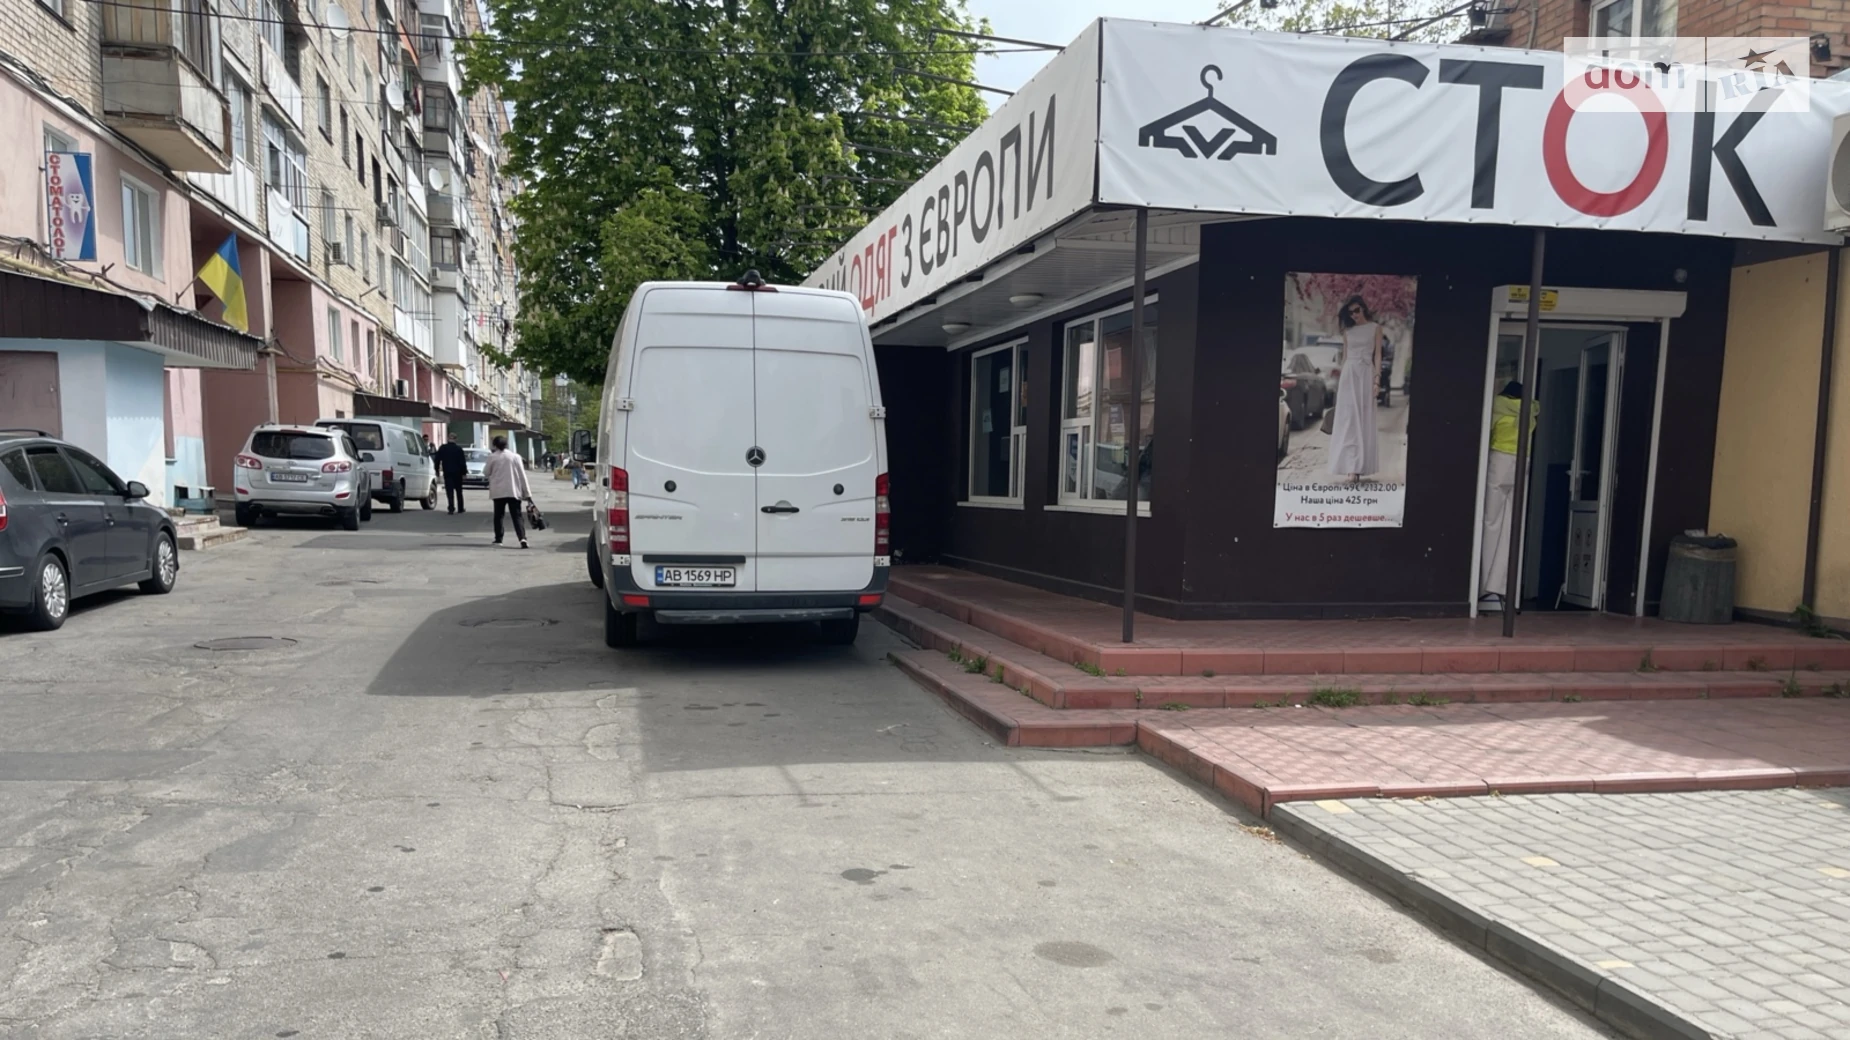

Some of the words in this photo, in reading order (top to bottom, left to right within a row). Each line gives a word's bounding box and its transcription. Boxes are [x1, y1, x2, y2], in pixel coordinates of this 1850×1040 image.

[1320, 53, 1785, 227] СТОК
[49, 154, 65, 258] СТОМАТОЛОГ
[850, 224, 897, 317] ОДЯГ
[919, 93, 1056, 276] ЄВРОПИ
[1283, 483, 1303, 492] Ціна
[1312, 483, 1342, 493] Європі
[1301, 496, 1324, 504] Наша
[1326, 496, 1344, 505] ціна
[1346, 496, 1361, 504] 425
[1363, 497, 1378, 506] грн
[1320, 513, 1325, 521] 5
[1327, 515, 1342, 523] раз
[664, 570, 682, 582] AB
[684, 570, 711, 582] 1569
[714, 570, 732, 582] HP
